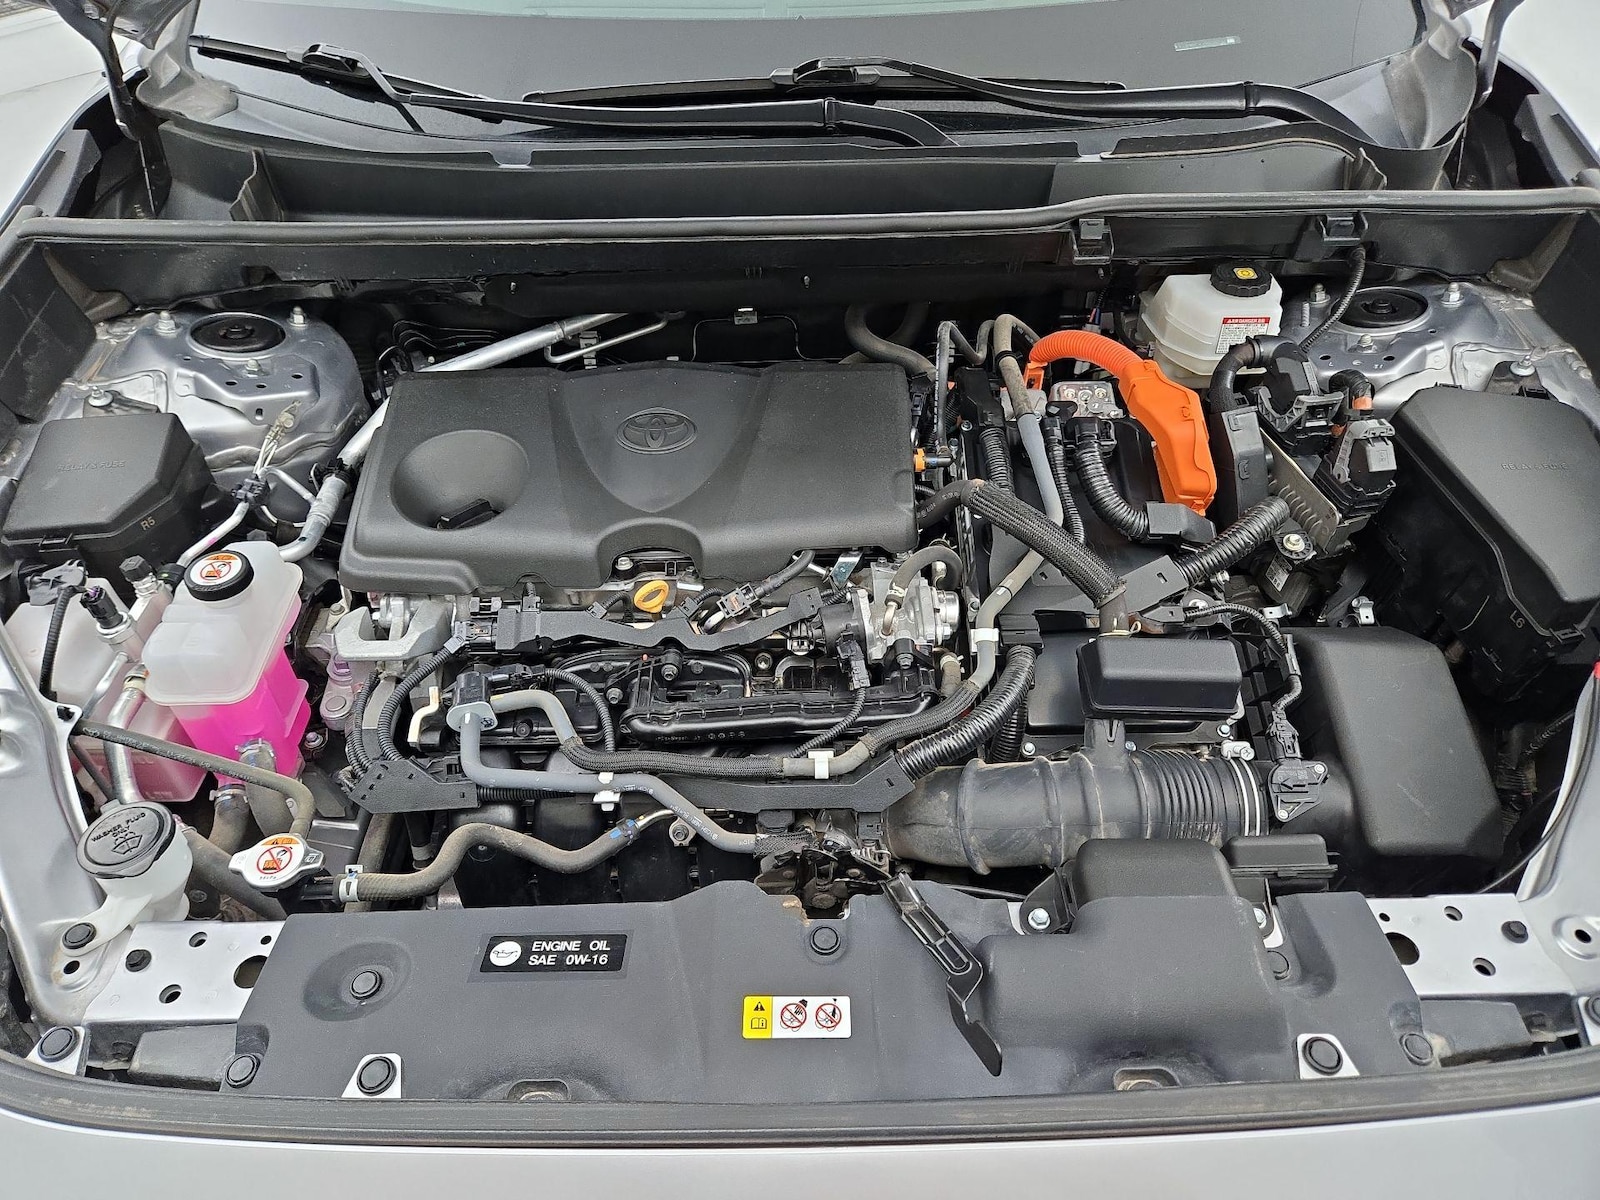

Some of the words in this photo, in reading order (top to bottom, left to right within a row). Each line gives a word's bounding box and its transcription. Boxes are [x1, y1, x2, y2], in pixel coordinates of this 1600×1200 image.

[140, 516, 156, 531] R5
[1510, 610, 1525, 629] L6
[91, 824, 122, 842] WASHER
[126, 812, 146, 825] FLUID
[112, 825, 130, 838] ONLY
[532, 940, 581, 952] ENGINE
[589, 940, 611, 951] OIL
[528, 954, 557, 966] SAE
[566, 954, 609, 966] 0W-16
